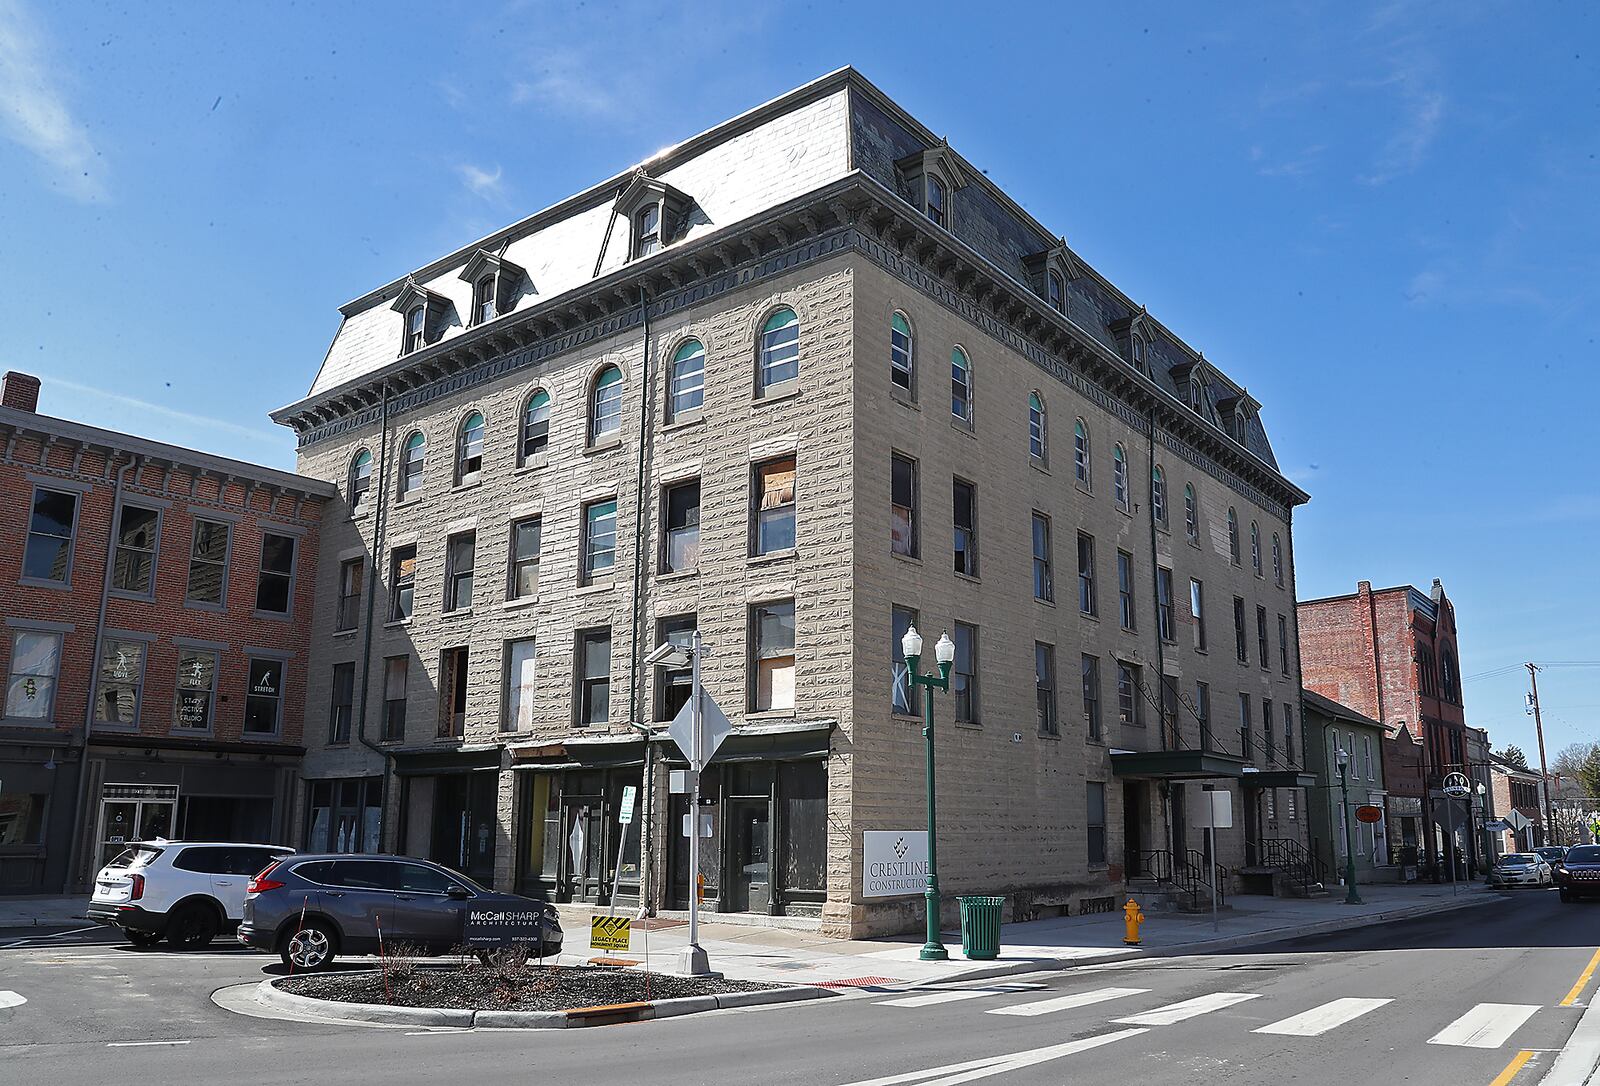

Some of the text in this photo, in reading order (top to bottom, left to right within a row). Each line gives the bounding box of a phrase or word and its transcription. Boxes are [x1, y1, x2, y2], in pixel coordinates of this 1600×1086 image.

[254, 685, 275, 693] STRETCH
[180, 714, 203, 722] STUDIO
[870, 861, 929, 878] CRESTLINE
